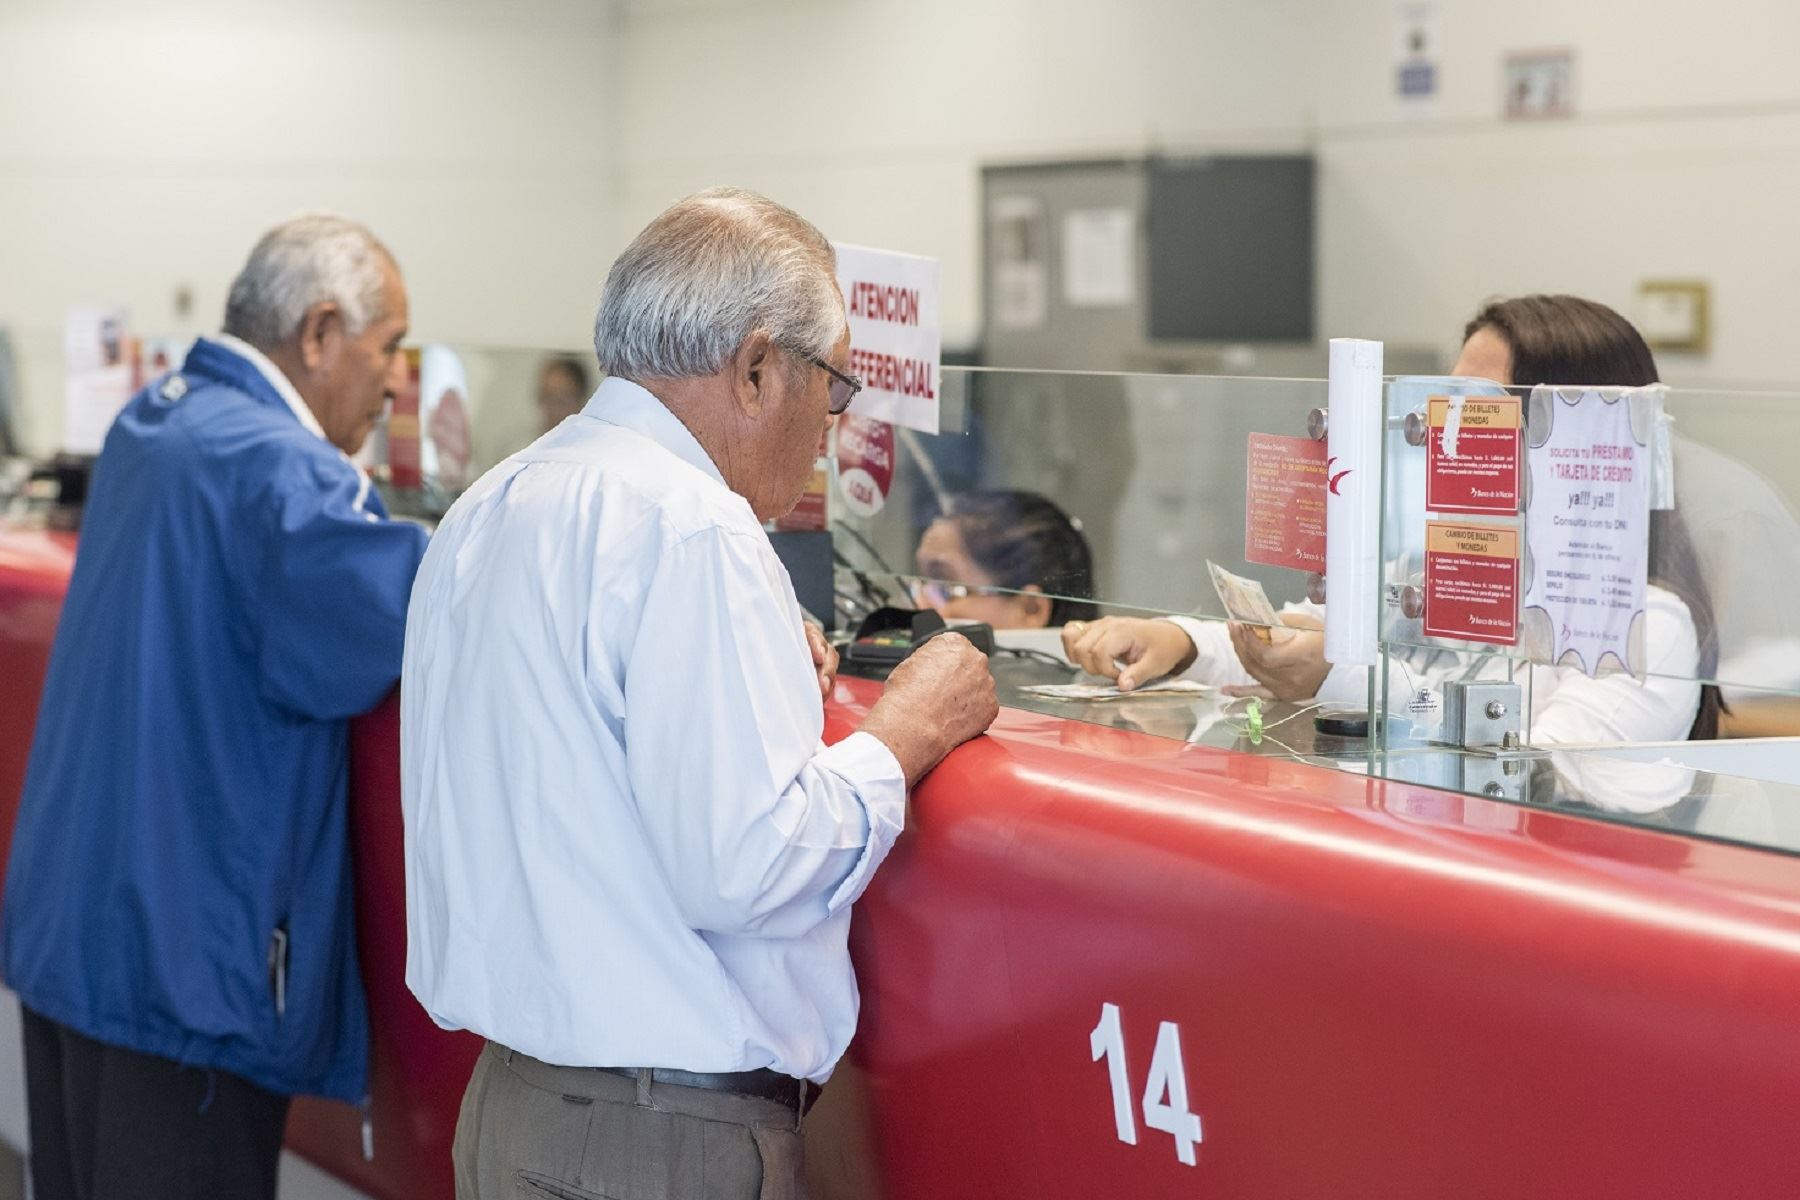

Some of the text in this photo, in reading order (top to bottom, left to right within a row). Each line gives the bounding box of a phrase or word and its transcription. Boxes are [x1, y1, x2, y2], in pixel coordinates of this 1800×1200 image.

[850, 281, 918, 327] ATENCION
[1550, 448, 1580, 458] SOLICITA
[1581, 449, 1590, 459] TU
[1557, 464, 1589, 480] TARJETA
[1591, 465, 1601, 481] DE
[1569, 491, 1614, 510] ya!!! ya!!!
[1553, 515, 1587, 527] Consulta
[1589, 519, 1603, 528] con
[1604, 520, 1613, 529] tu
[1445, 530, 1499, 542] CAMBIO DE BILLETES
[1461, 543, 1488, 552] MONEDAS
[1090, 1002, 1202, 1166] 14
